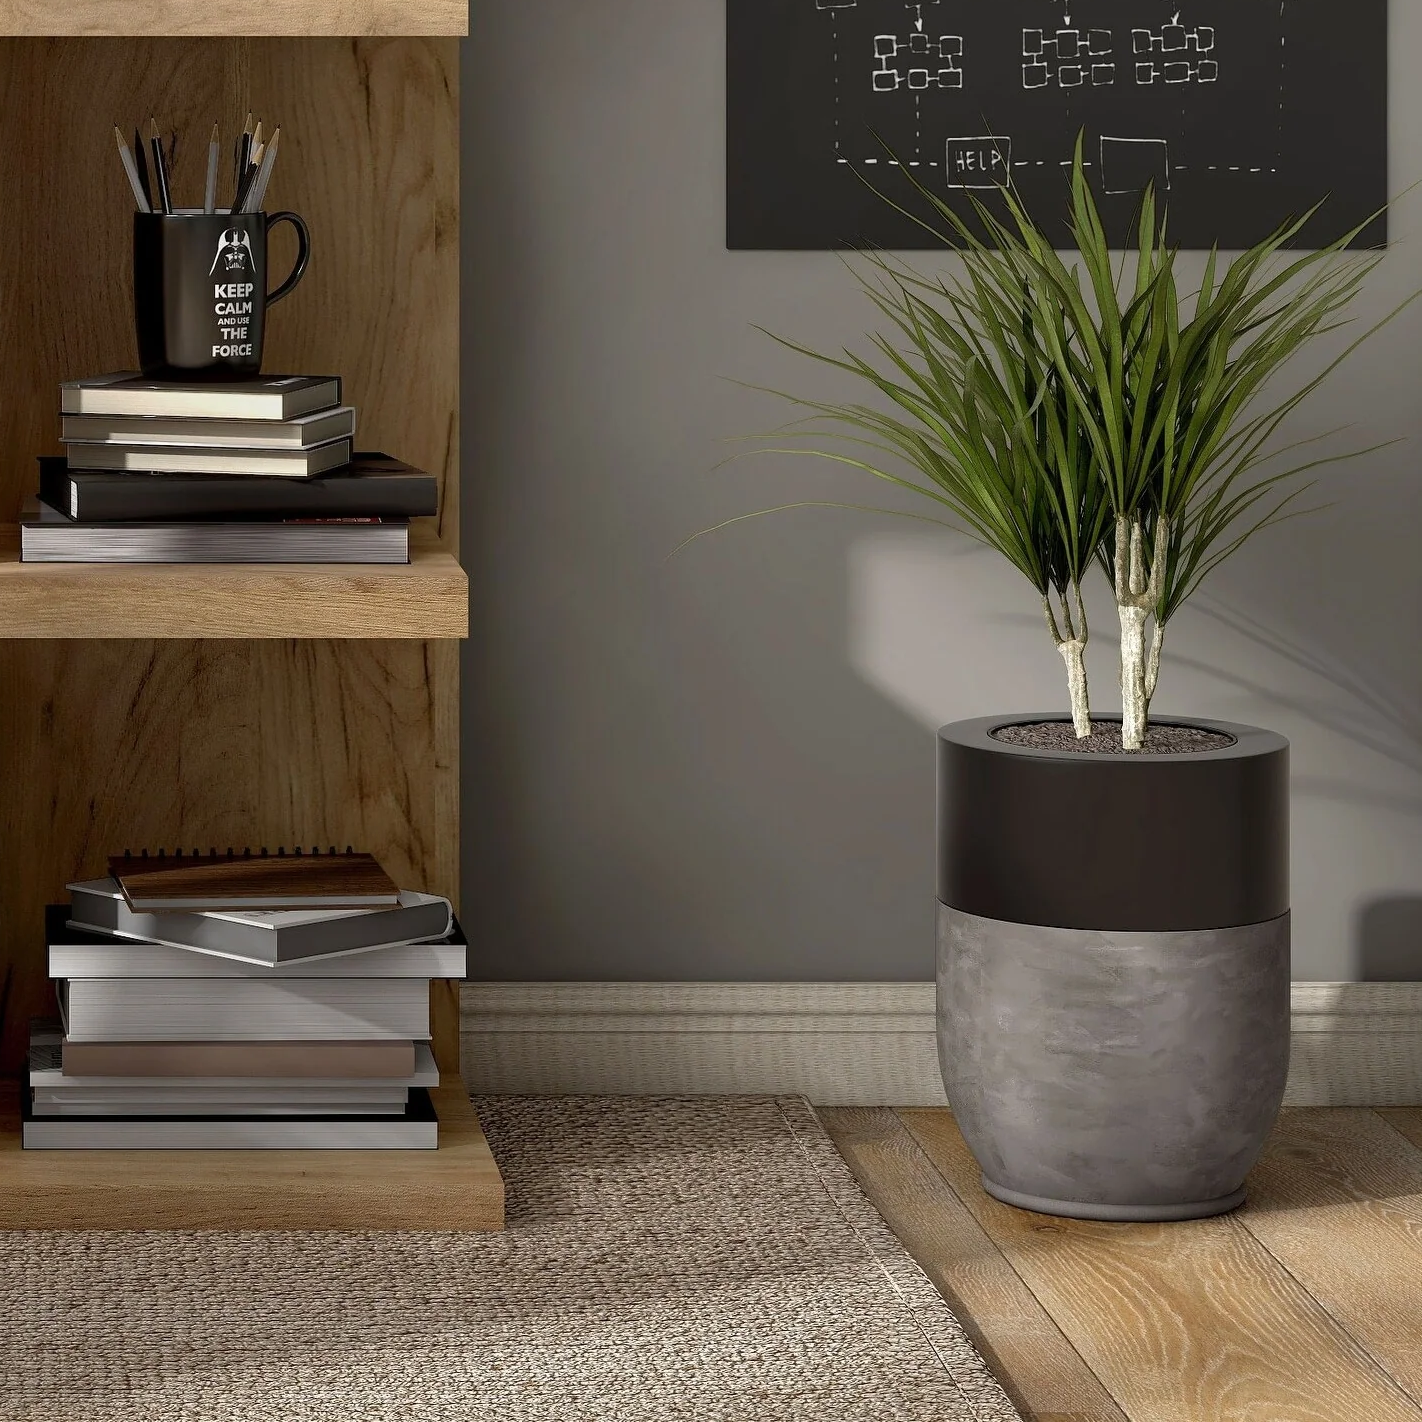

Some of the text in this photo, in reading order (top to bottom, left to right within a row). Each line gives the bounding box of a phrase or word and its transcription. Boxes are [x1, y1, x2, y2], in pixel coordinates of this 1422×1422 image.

[955, 149, 1001, 173] HELP
[214, 282, 254, 299] KEEP
[214, 301, 252, 315] CALM
[217, 316, 250, 326] AND USE
[220, 327, 248, 340] THE
[212, 343, 252, 358] FORCE
